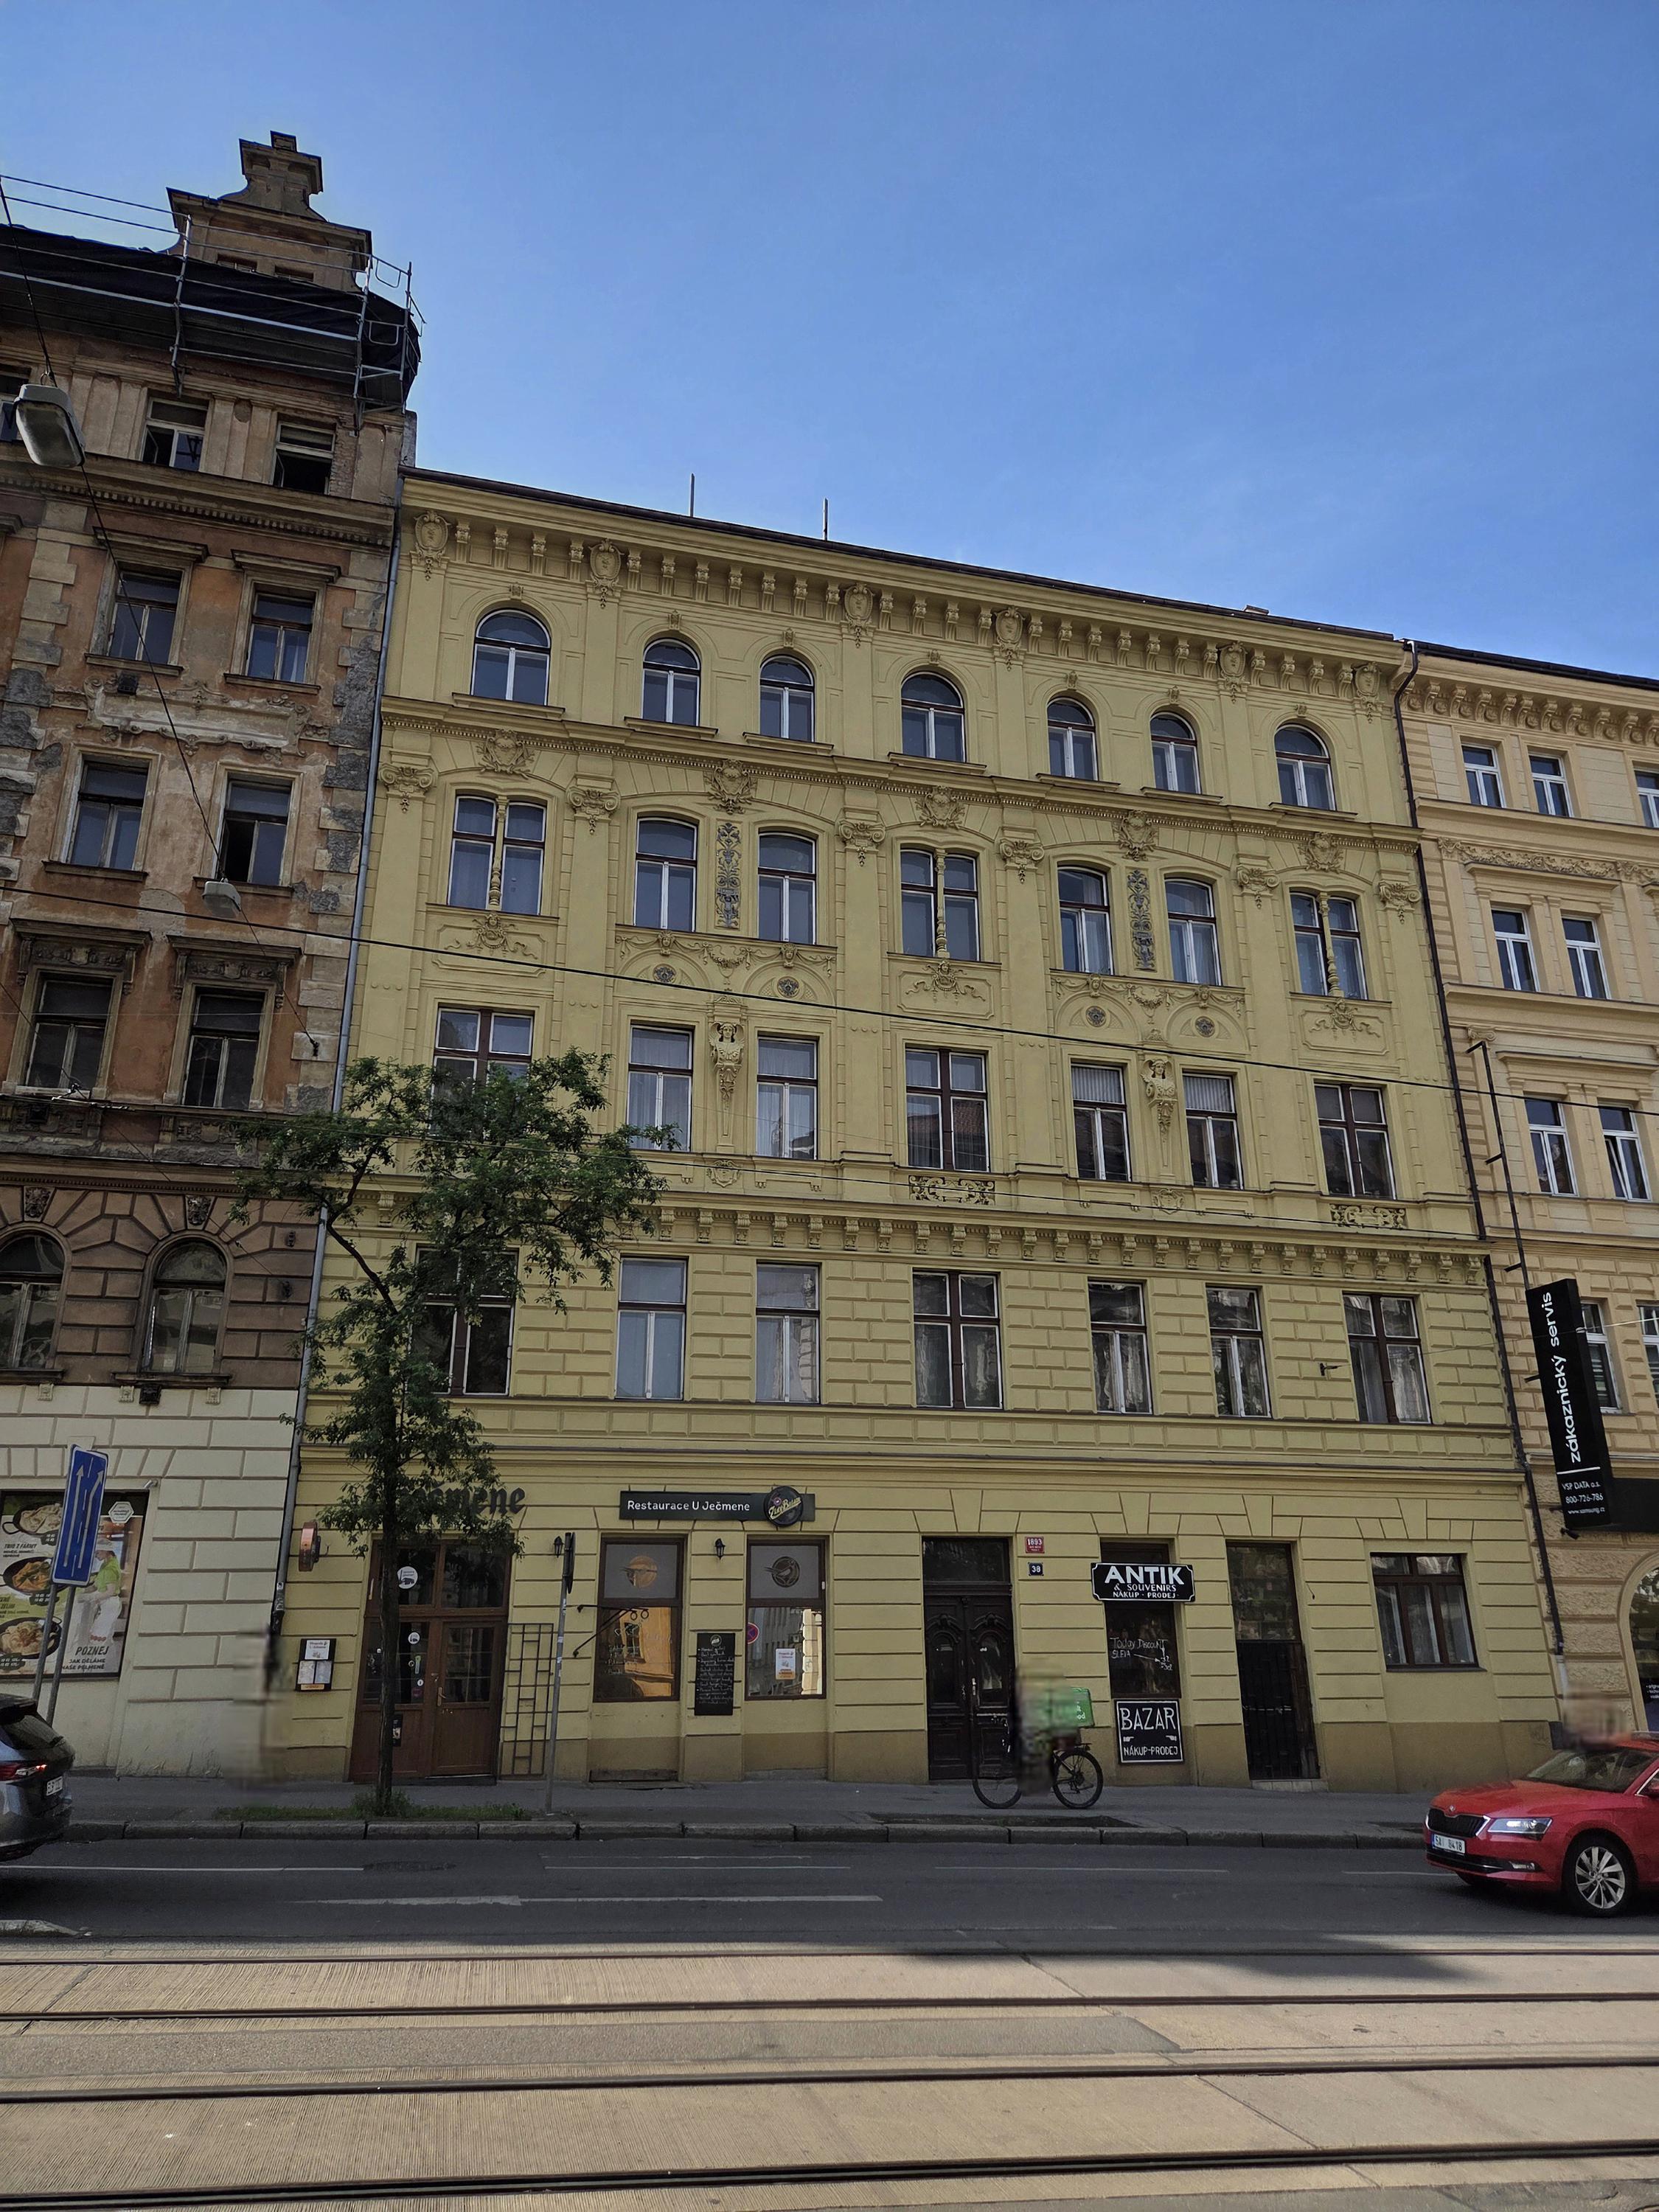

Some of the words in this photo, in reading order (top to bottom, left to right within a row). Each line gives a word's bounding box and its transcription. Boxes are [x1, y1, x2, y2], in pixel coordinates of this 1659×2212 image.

[1541, 1292, 1559, 1347] servis
[1551, 1355, 1581, 1464] zákaznický
[1573, 1481, 1590, 1489] DATA
[627, 1500, 689, 1511] Restaurace
[692, 1501, 699, 1510] U
[702, 1500, 750, 1512] Ječmene
[1105, 1565, 1184, 1585] ANTIK
[1113, 1583, 1121, 1591] &
[1127, 1584, 1177, 1592] SOUVENIRS
[75, 1646, 109, 1655] POZNEJ
[1119, 1707, 1176, 1730] BAZAR
[1123, 1745, 1178, 1756] NÁKUP-PRODEJ
